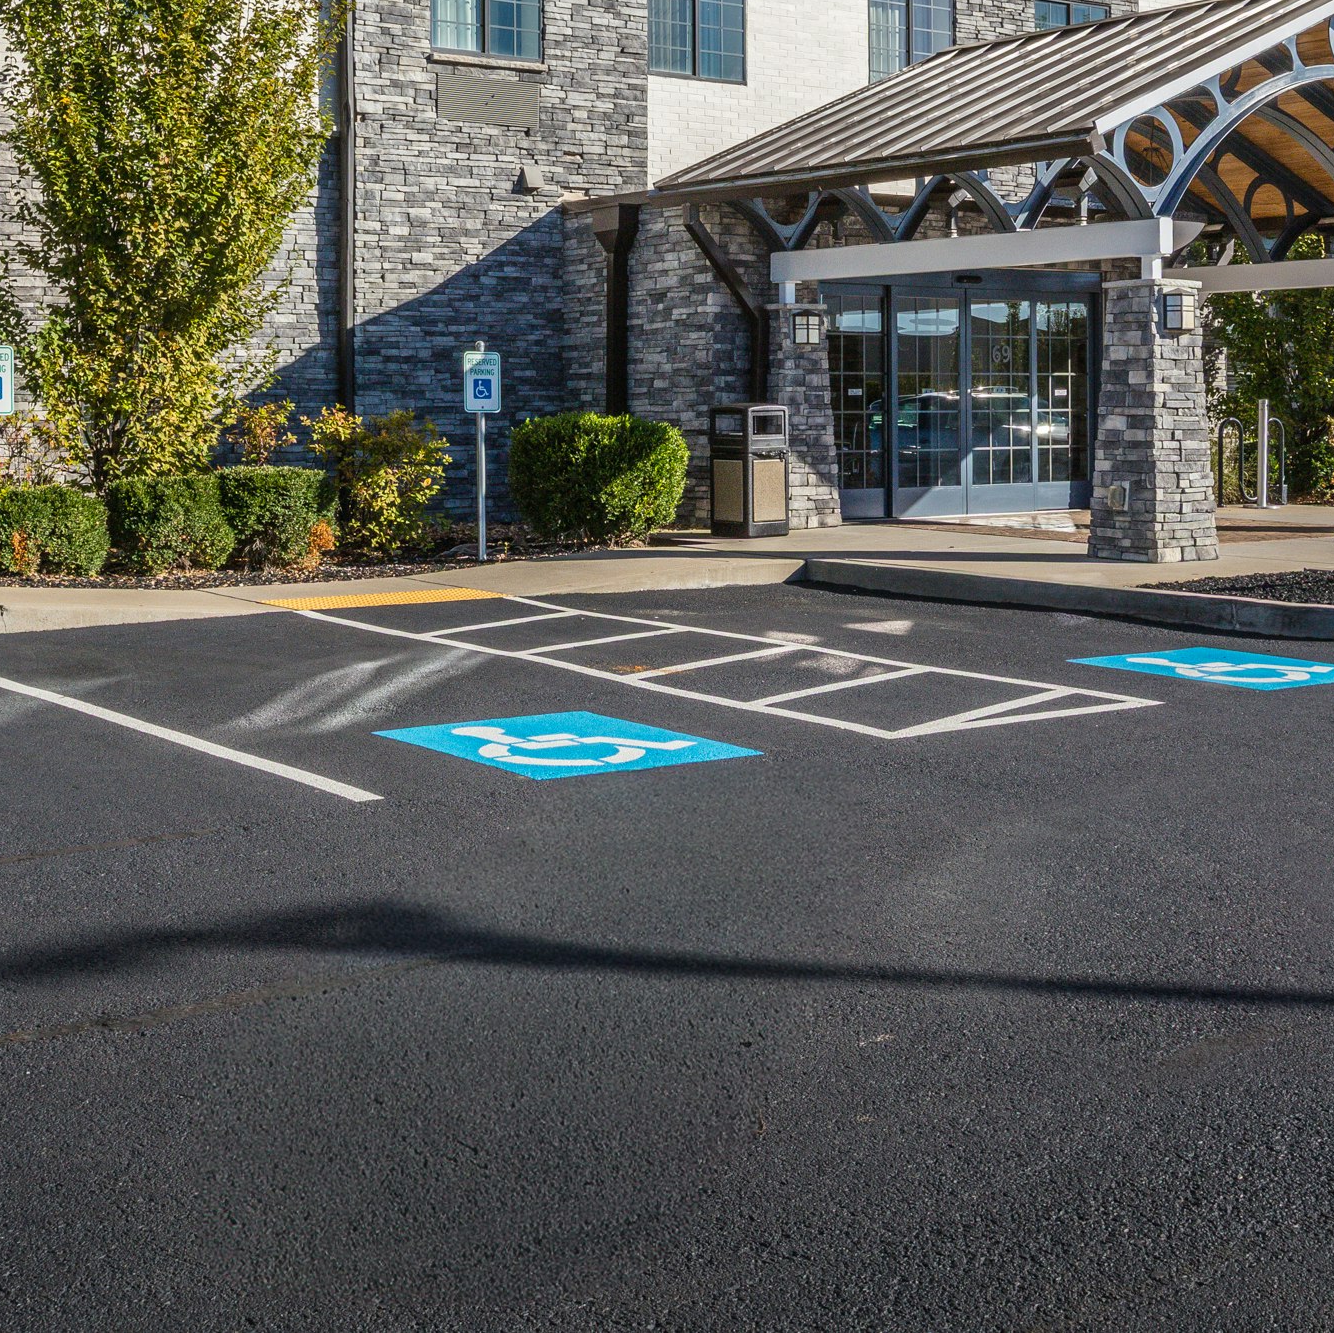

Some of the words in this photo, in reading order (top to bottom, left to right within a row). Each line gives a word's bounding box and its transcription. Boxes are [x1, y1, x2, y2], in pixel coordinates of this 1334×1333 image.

[992, 345, 1010, 363] 69
[467, 358, 497, 366] RESERVED
[470, 368, 495, 376] PARKING
